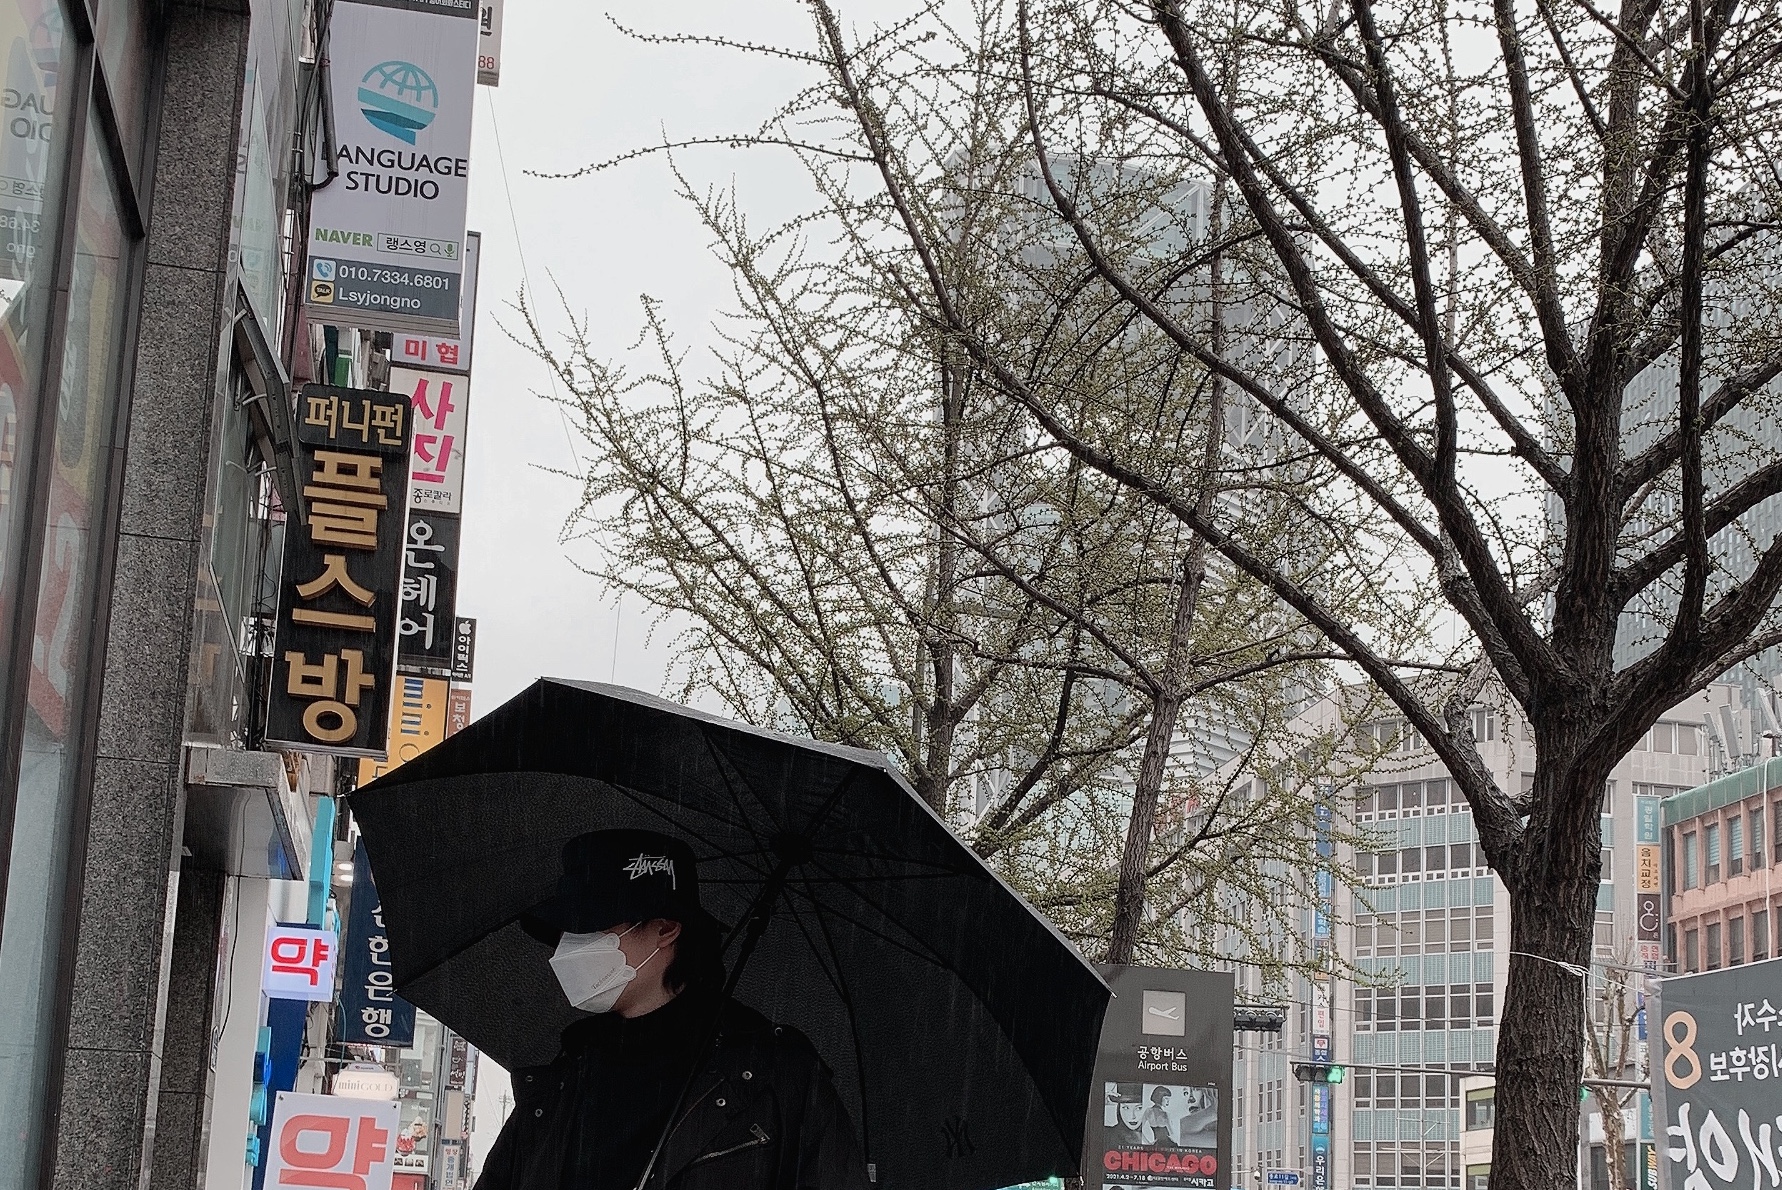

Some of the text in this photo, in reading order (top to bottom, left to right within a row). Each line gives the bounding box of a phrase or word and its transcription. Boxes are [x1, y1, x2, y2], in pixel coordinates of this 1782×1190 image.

[345, 171, 440, 200] STUDIO
[315, 227, 373, 247] NAVER
[386, 236, 427, 254] 랭스영
[339, 265, 449, 291] 010.7334.6801
[338, 287, 421, 310] Lsyjongno
[304, 395, 405, 447] 퍼니펀
[411, 378, 455, 484] 사진
[413, 487, 452, 504] 종로칼라
[284, 448, 388, 744] 플스방
[400, 519, 445, 650] 온헤어
[451, 701, 466, 735] 보청
[270, 936, 329, 986] 약
[1137, 1045, 1188, 1060] 공항버스
[1137, 1060, 1188, 1072] Airport Bus
[1103, 1150, 1218, 1176] CHICAGO
[1647, 1145, 1658, 1190] SUBWAY
